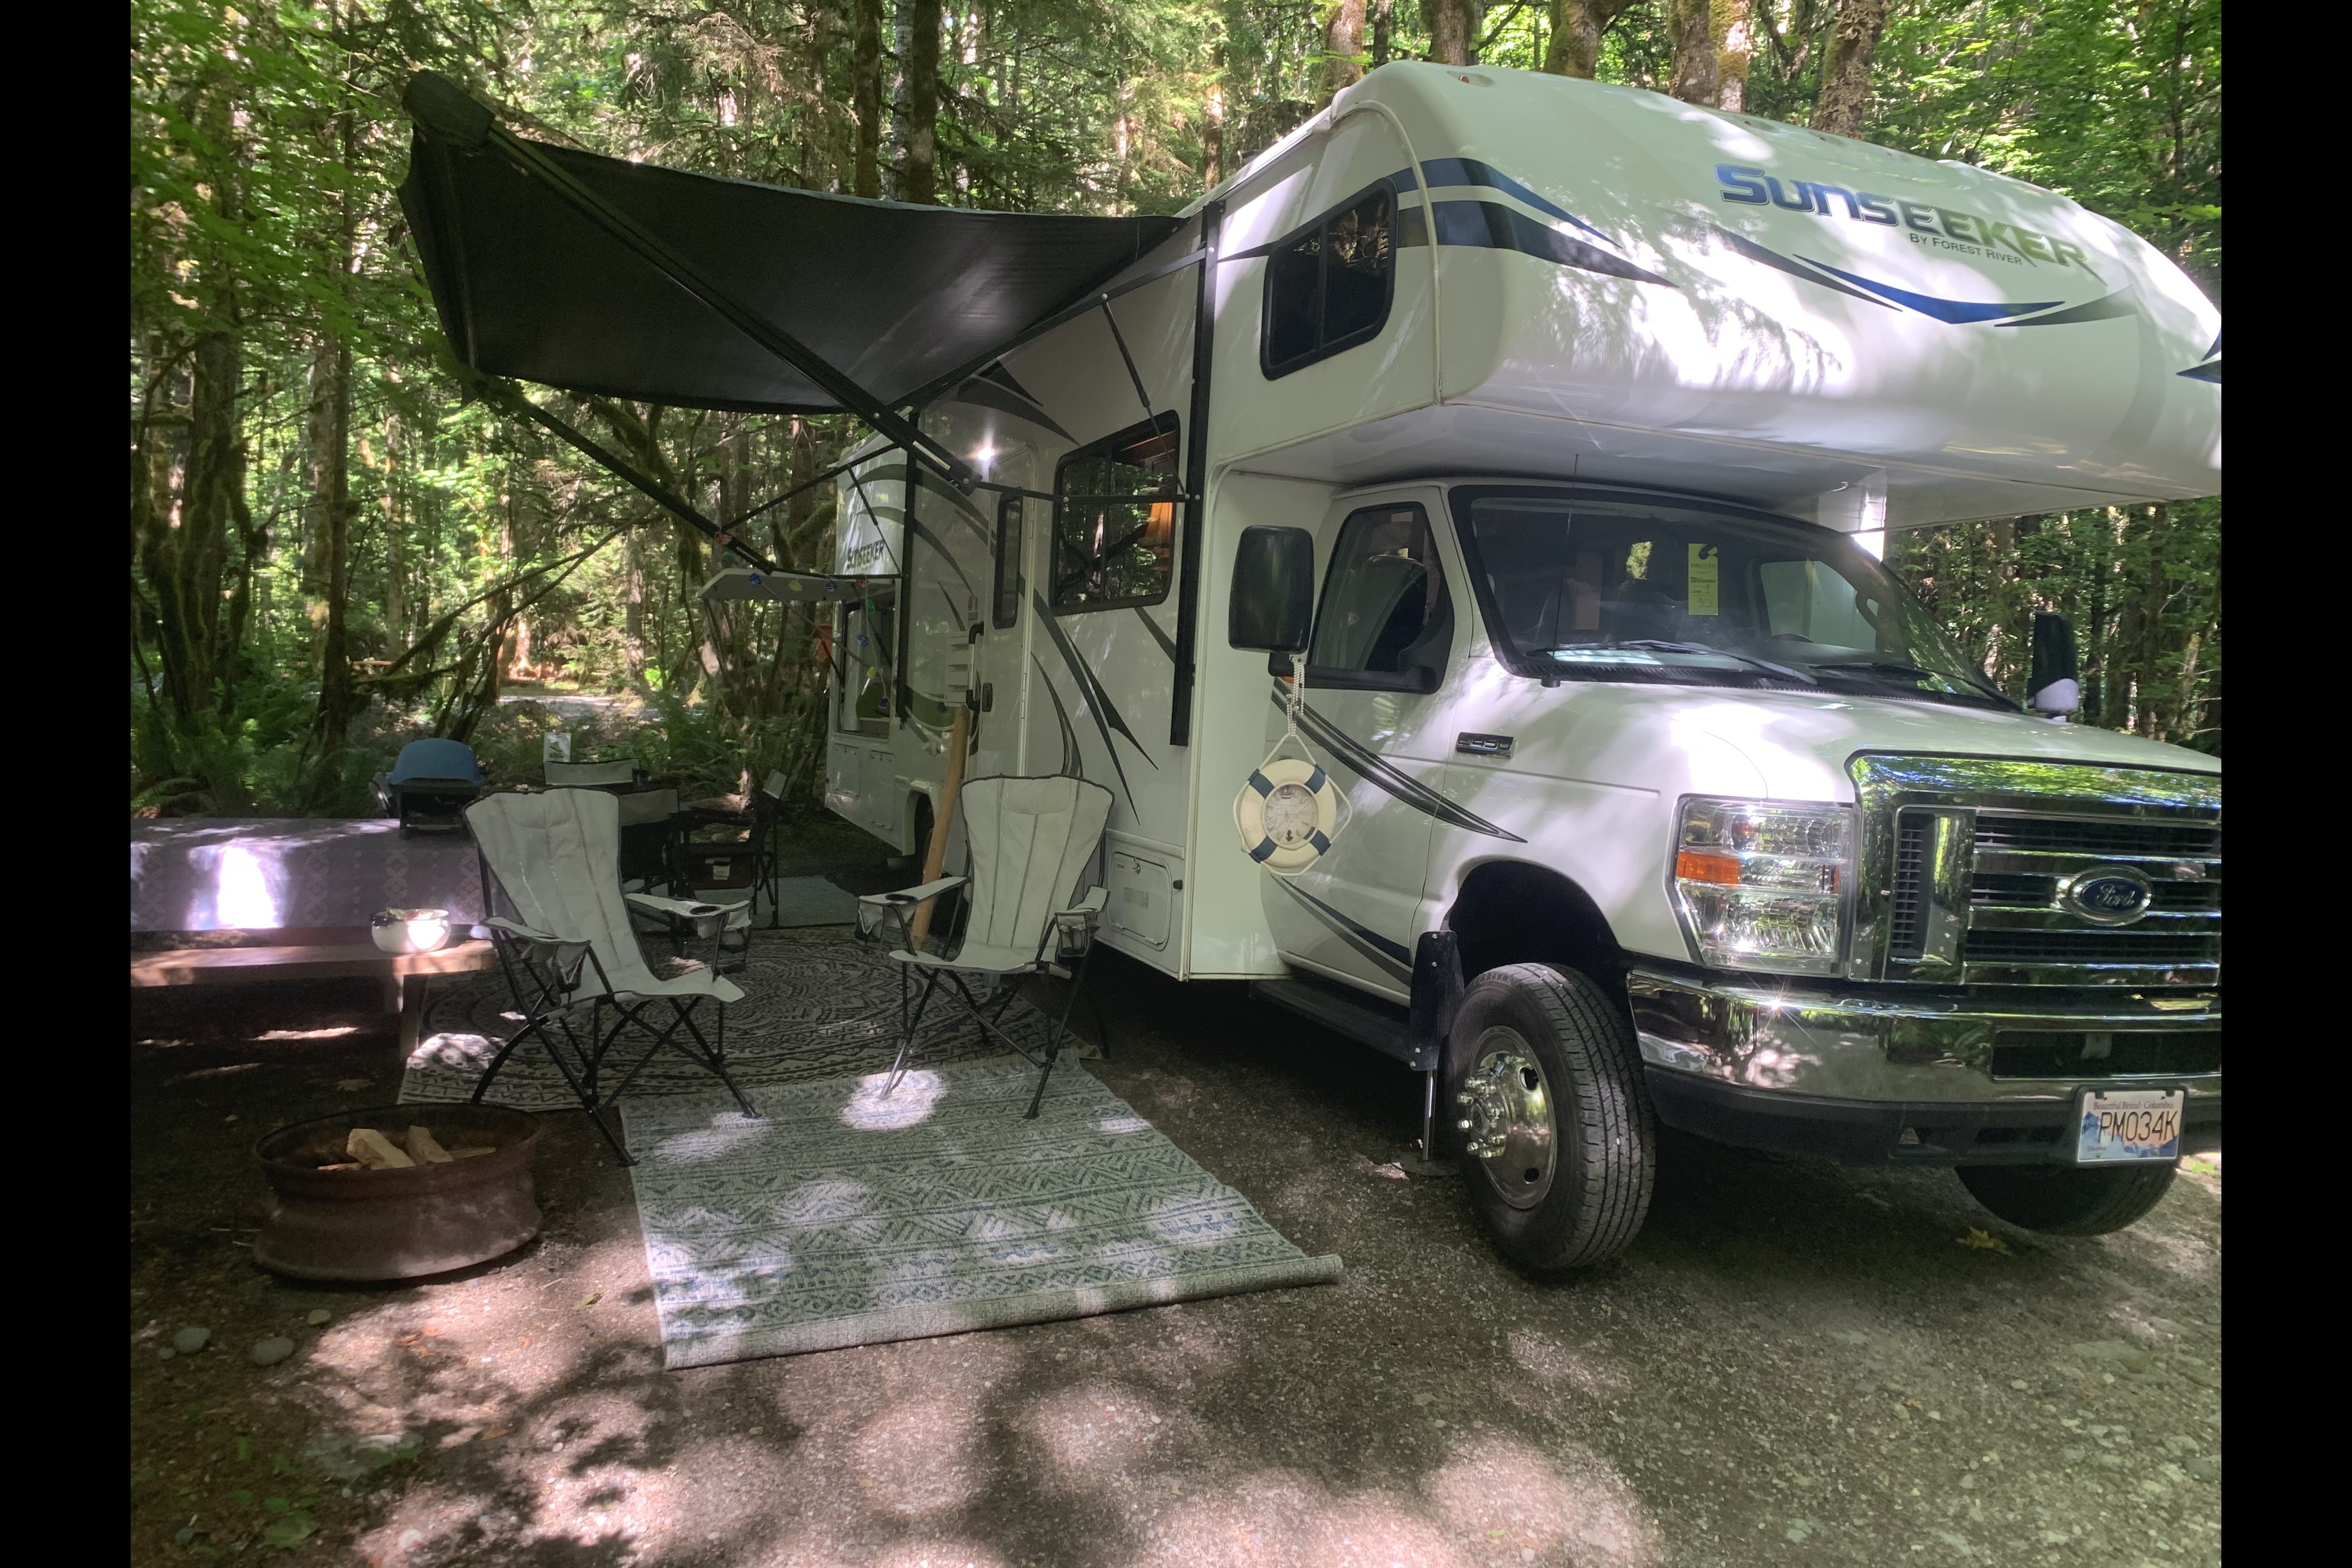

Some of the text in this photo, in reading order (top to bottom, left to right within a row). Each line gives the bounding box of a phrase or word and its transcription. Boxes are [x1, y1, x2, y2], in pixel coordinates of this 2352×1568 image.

[1909, 233, 2023, 265] BY FOREST RIVER
[2096, 883, 2135, 906] Ford
[2098, 1111, 2178, 1144] PM034K
